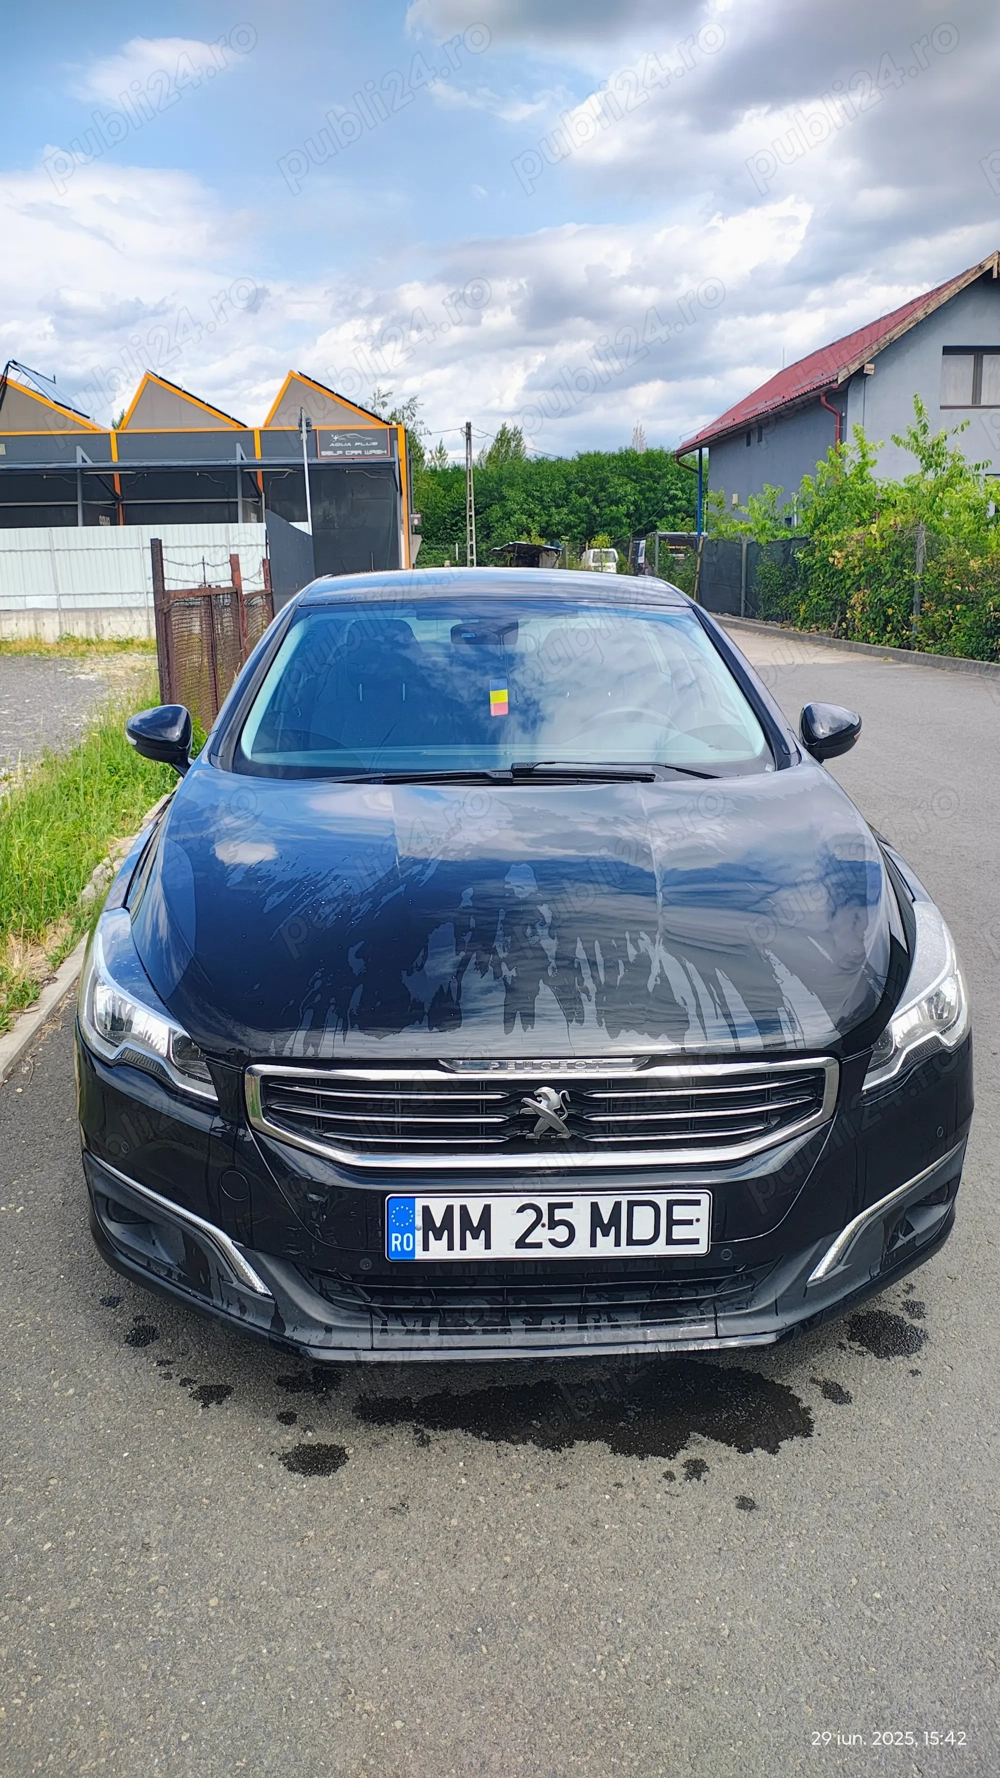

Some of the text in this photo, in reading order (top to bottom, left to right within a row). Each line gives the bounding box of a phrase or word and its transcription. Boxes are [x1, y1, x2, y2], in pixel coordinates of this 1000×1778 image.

[489, 1060, 603, 1071] PEUGEOT
[421, 1198, 701, 1252] MM 25 MDE
[391, 1233, 413, 1251] RO
